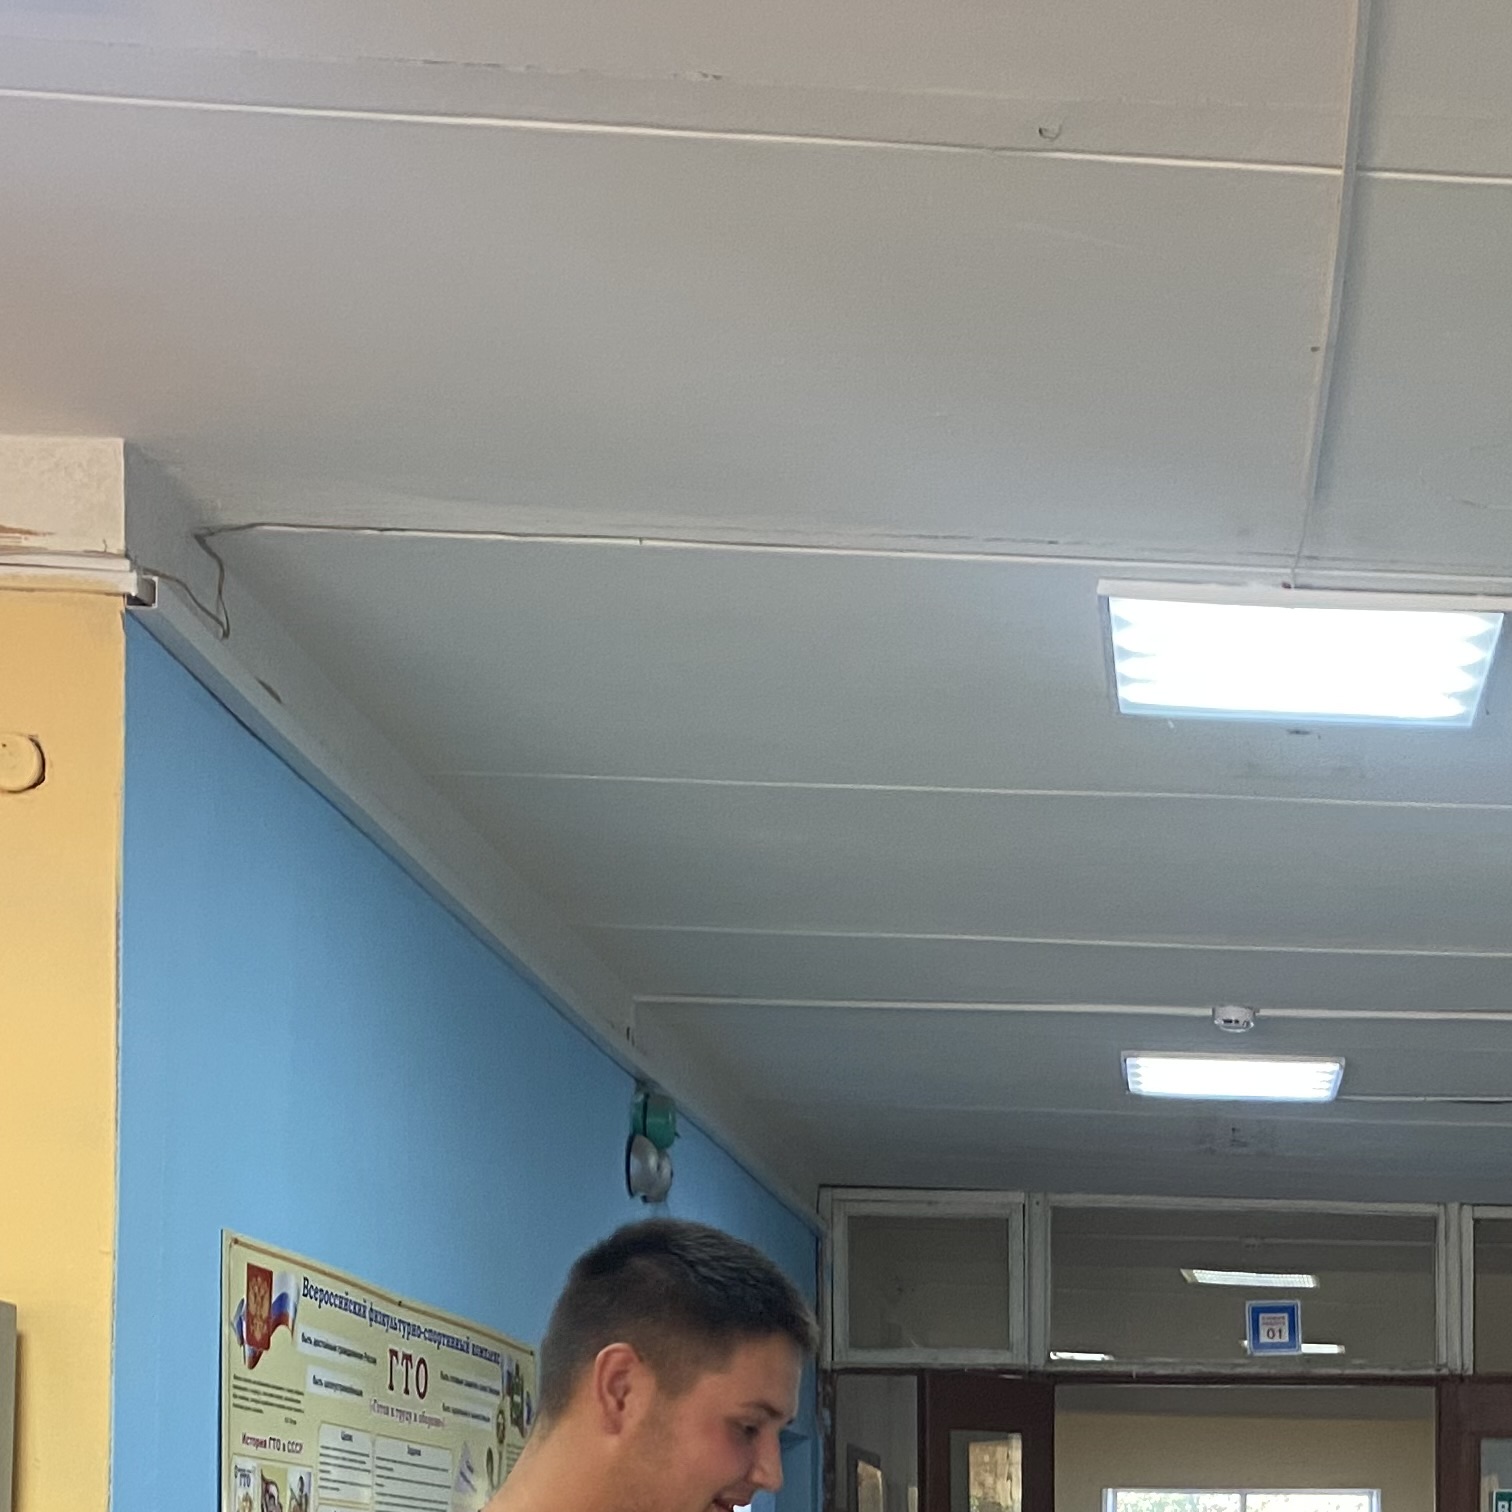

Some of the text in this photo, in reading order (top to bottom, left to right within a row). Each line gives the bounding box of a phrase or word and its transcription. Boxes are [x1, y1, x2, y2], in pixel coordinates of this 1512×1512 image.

[302, 1276, 367, 1319] Всероссийский
[1267, 1328, 1282, 1339] 01
[388, 1348, 428, 1400] ГТО
[269, 1437, 280, 1451] ГТО
